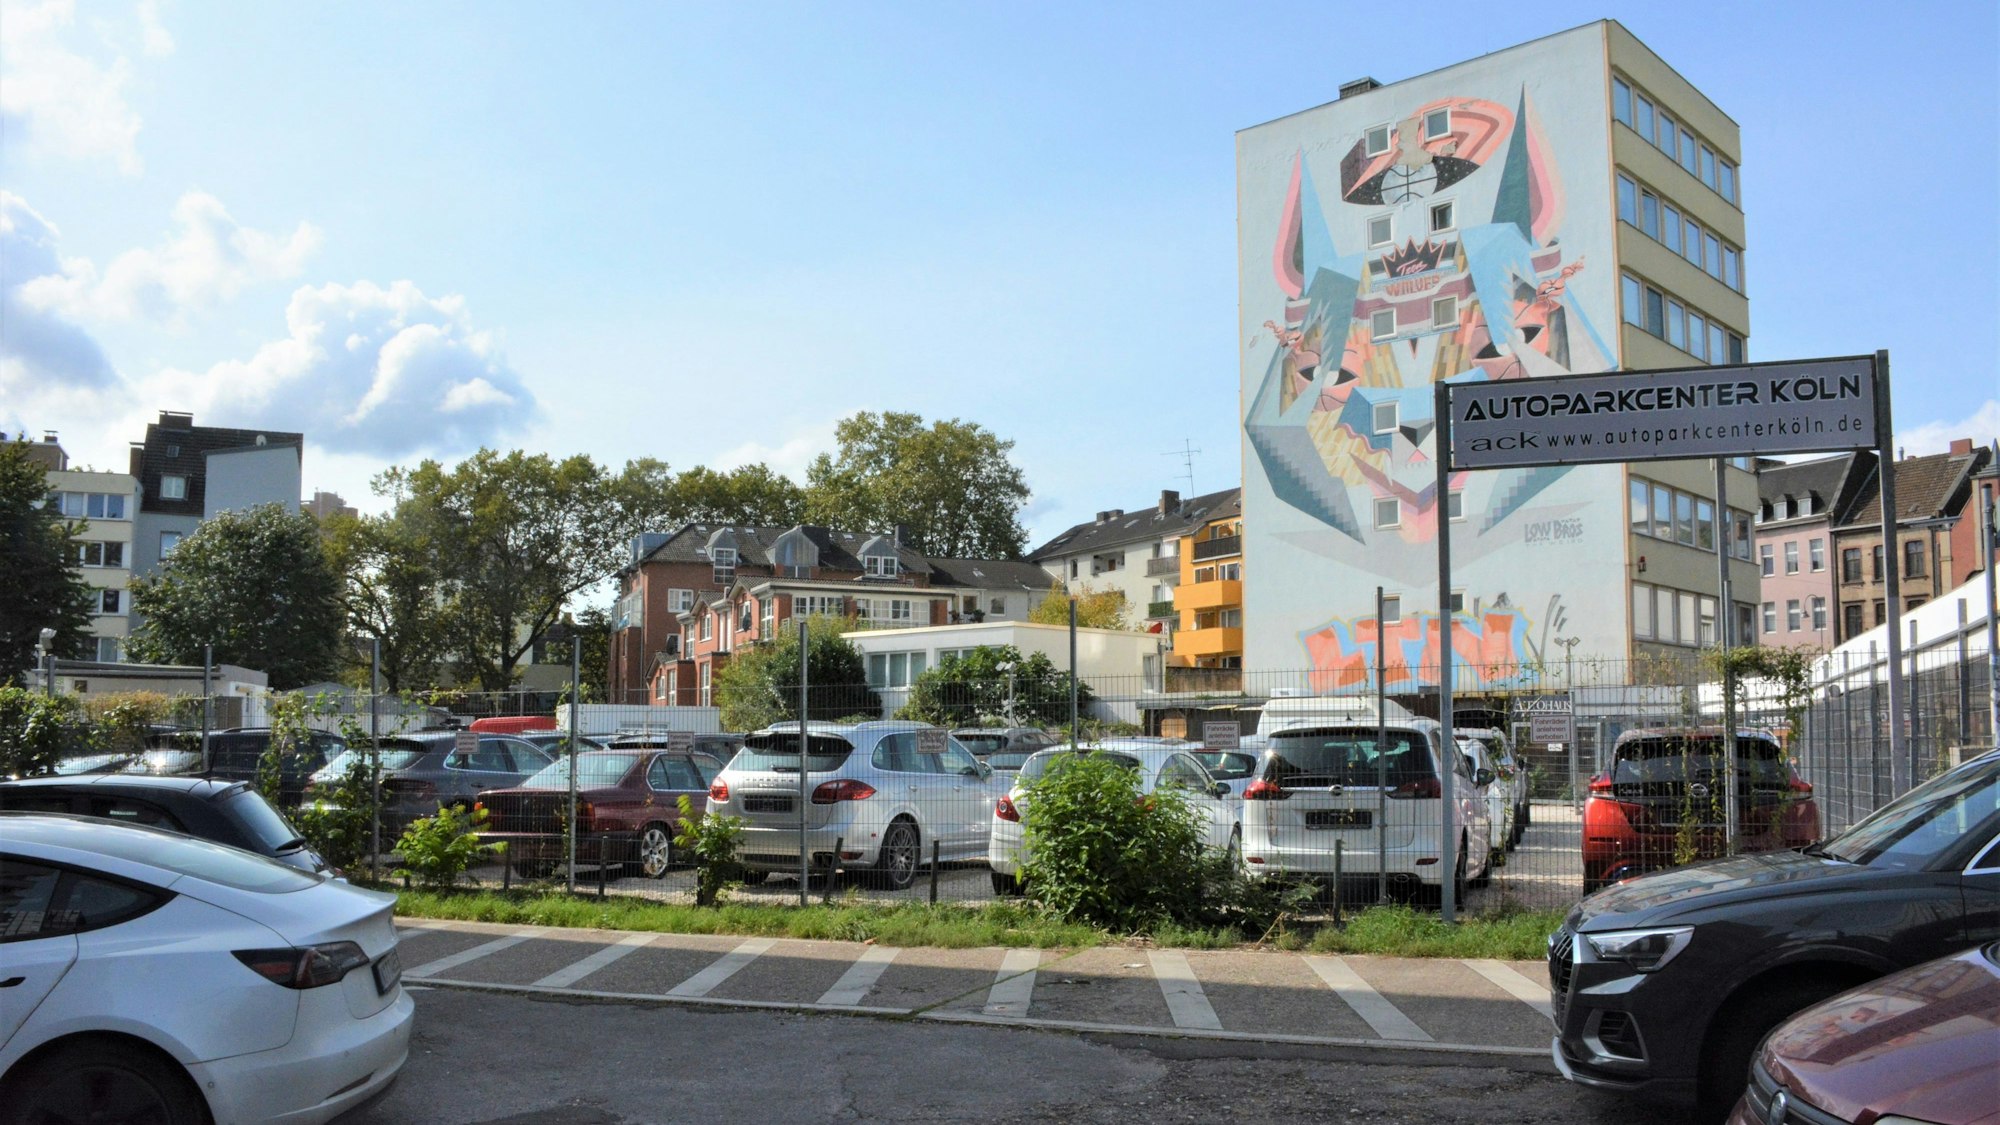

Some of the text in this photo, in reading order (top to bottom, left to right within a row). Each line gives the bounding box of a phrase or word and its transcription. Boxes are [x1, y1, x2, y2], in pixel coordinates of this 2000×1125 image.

[1463, 374, 1861, 421] AUTOPARKCENTER KÖLN
[1470, 415, 1862, 452] ack www.autoparkcenterköln.de
[1524, 519, 1583, 543] LOW BROS
